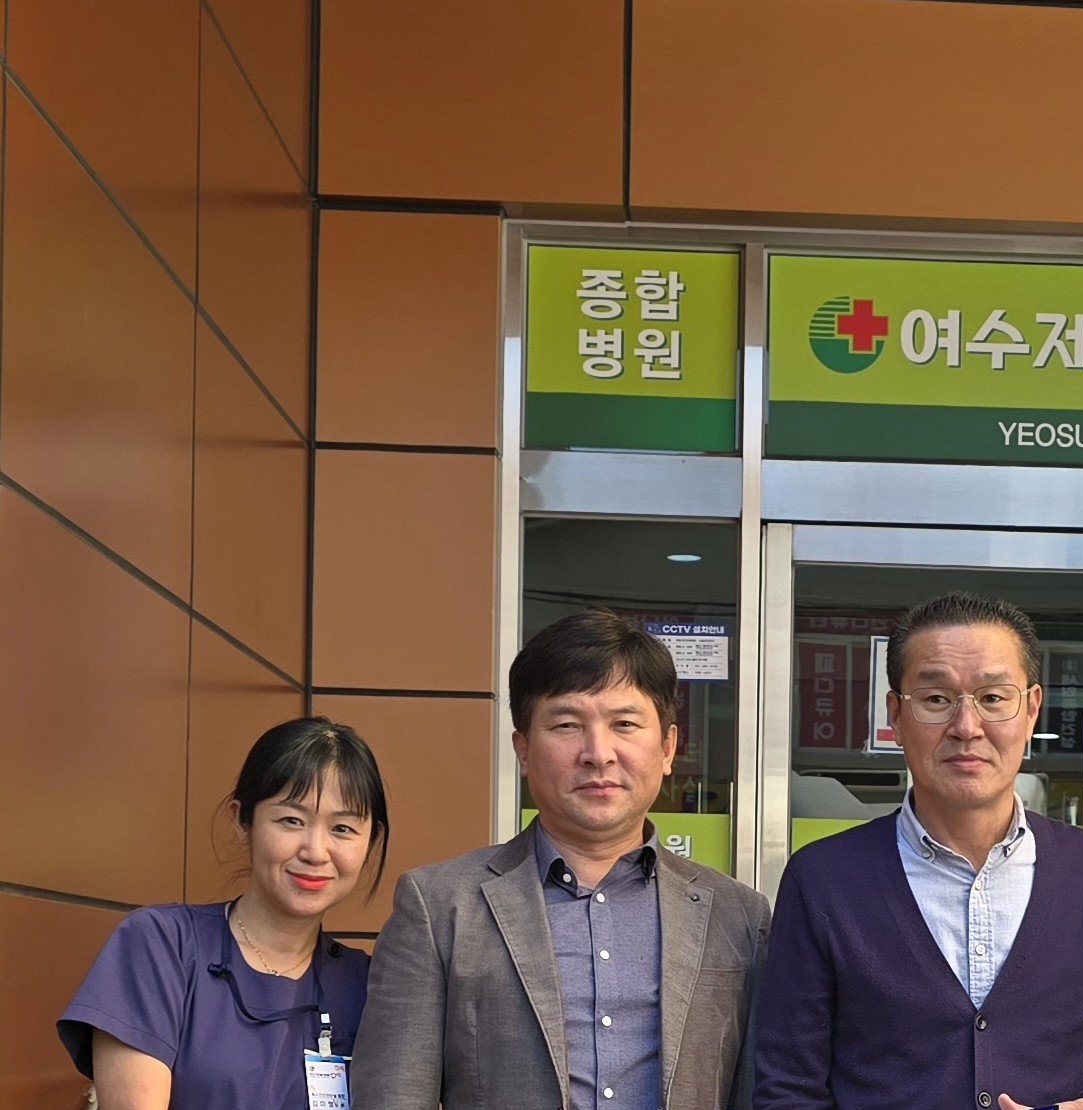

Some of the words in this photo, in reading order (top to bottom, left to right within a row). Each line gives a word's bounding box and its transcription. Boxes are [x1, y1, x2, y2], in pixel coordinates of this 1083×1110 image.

[579, 270, 684, 319] 종합
[579, 329, 681, 379] 병원
[662, 625, 691, 634] CCTV
[693, 625, 725, 634] 설치안내
